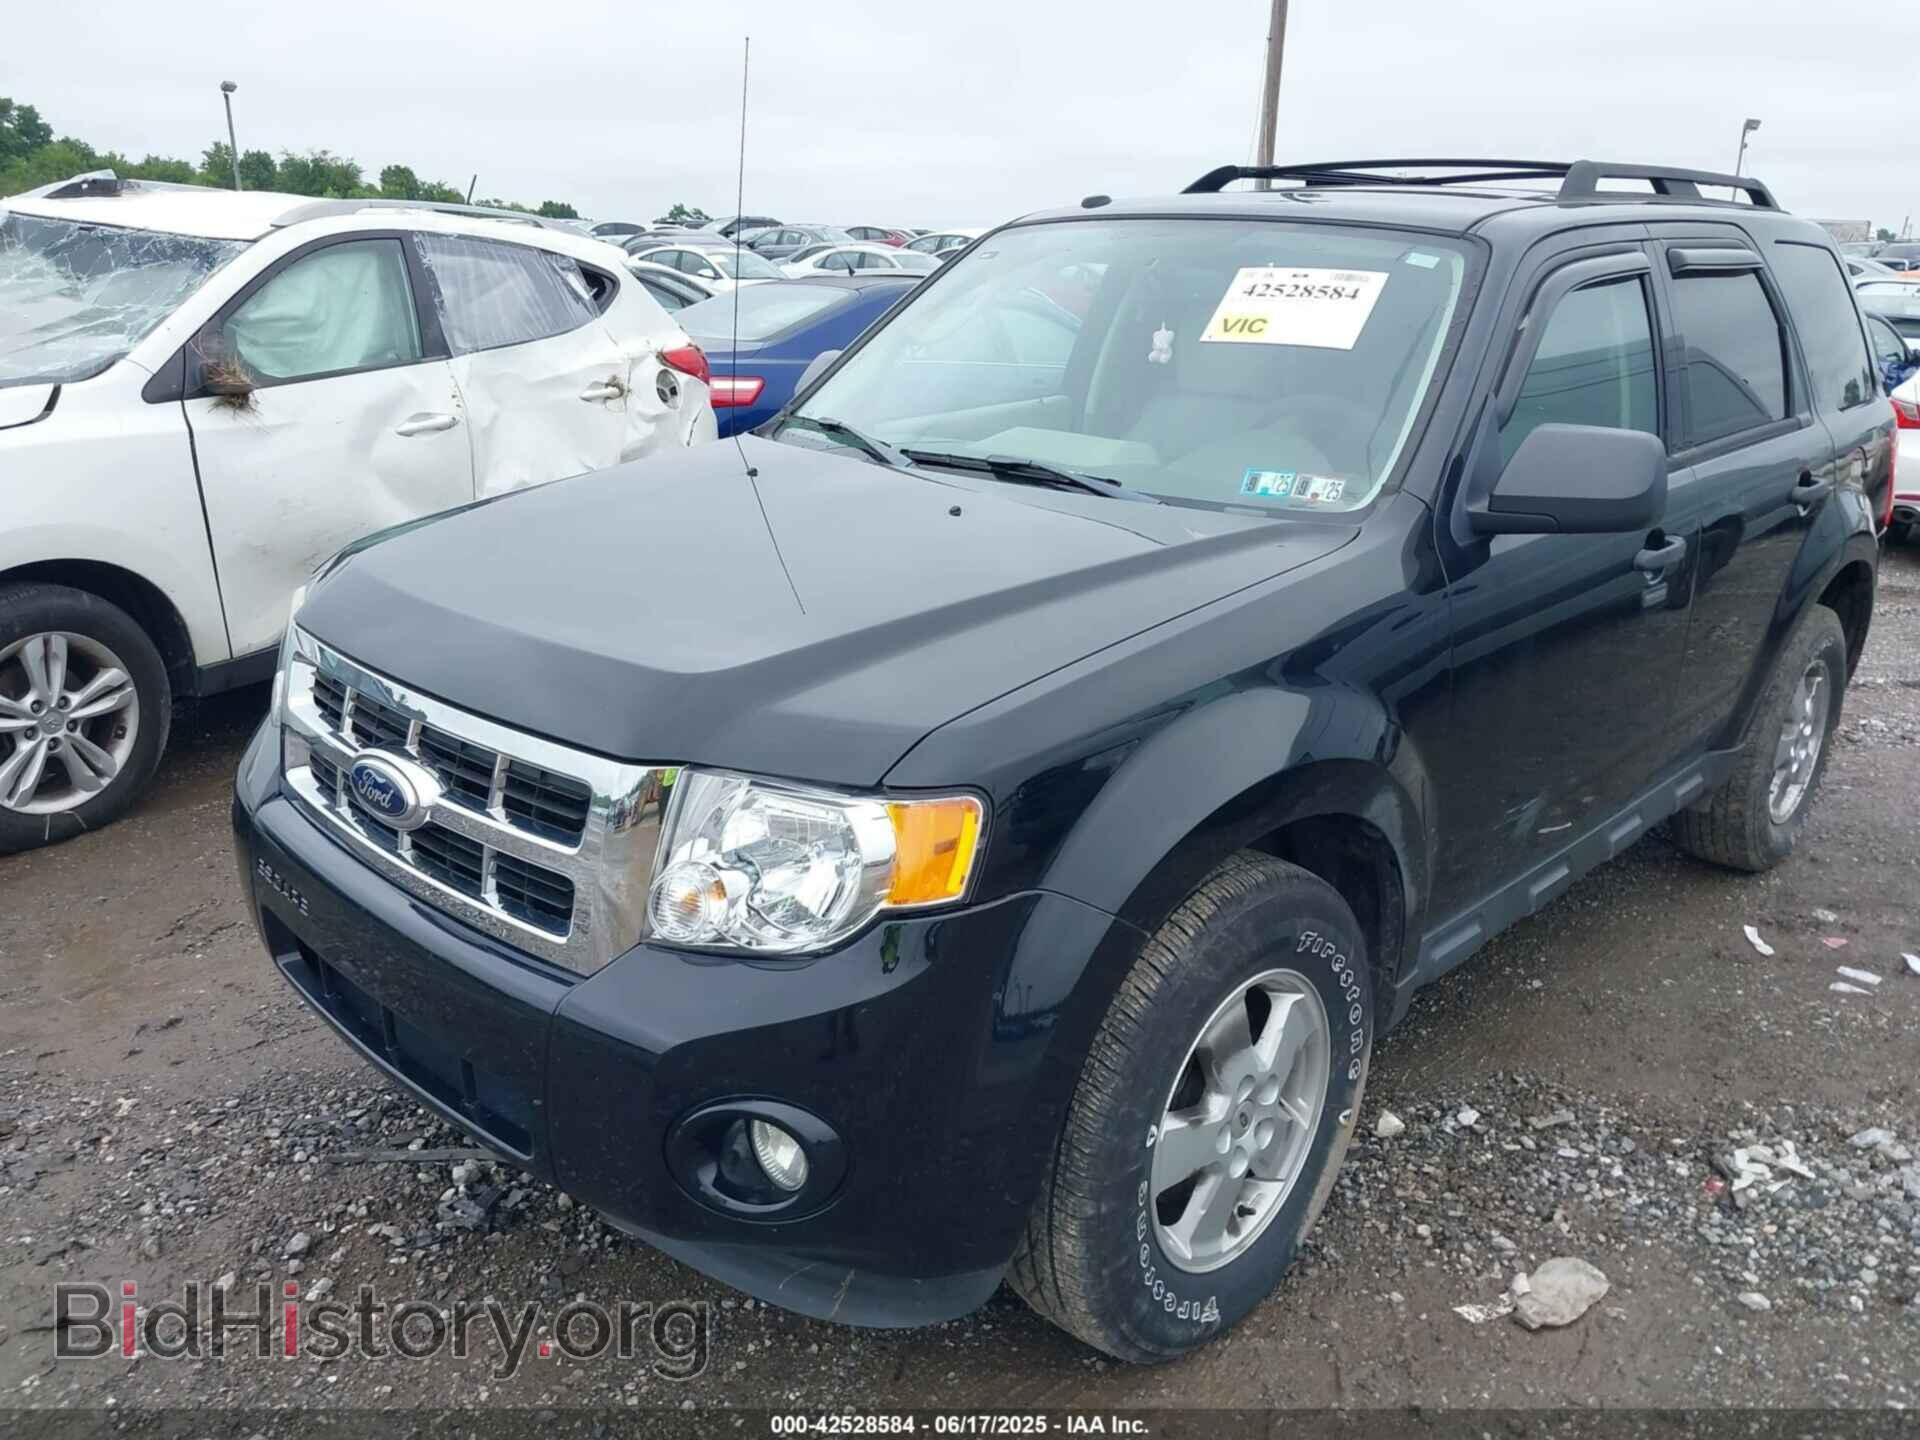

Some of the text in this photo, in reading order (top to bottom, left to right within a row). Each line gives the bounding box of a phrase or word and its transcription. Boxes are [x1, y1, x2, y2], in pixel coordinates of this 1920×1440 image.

[1243, 283, 1360, 300] 42528584
[1222, 317, 1269, 334] VIC
[357, 768, 394, 809] Ford
[1297, 931, 1363, 1080] Firestone
[1137, 1181, 1219, 1323] Firestone
